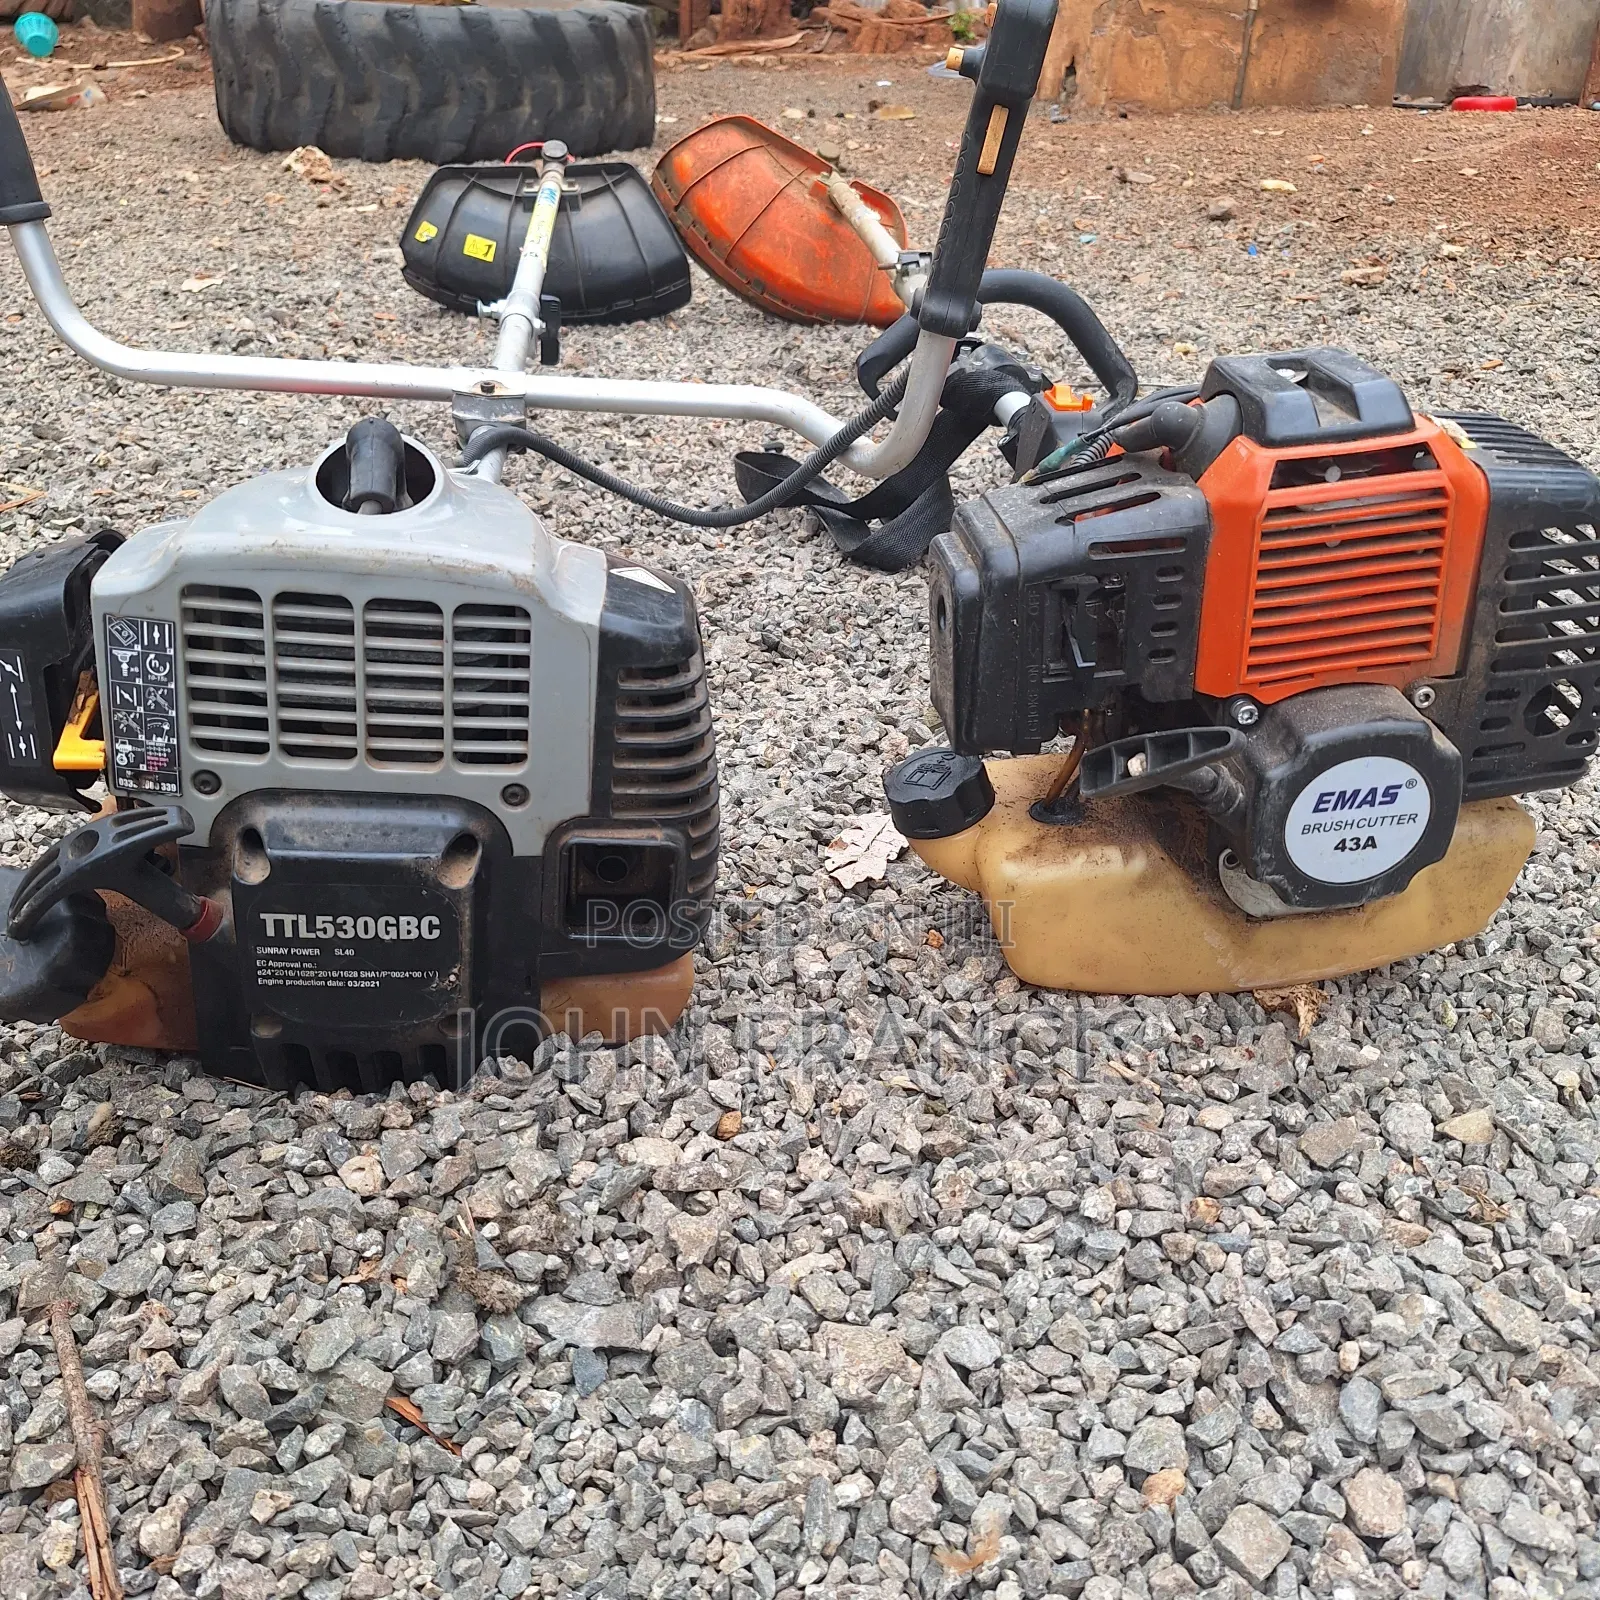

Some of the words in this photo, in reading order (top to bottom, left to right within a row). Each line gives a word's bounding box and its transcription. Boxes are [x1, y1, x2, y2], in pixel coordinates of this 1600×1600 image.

[1333, 836, 1378, 852] 43A
[259, 913, 441, 940] TTL530GBC
[256, 946, 289, 955] SUNRAY
[290, 947, 321, 956] POWER
[334, 948, 355, 956] SL40
[256, 959, 267, 967] EC
[268, 960, 301, 969] Approval
[258, 977, 284, 986] Engine
[327, 979, 346, 987] date:
[347, 980, 380, 988] 03/2021
